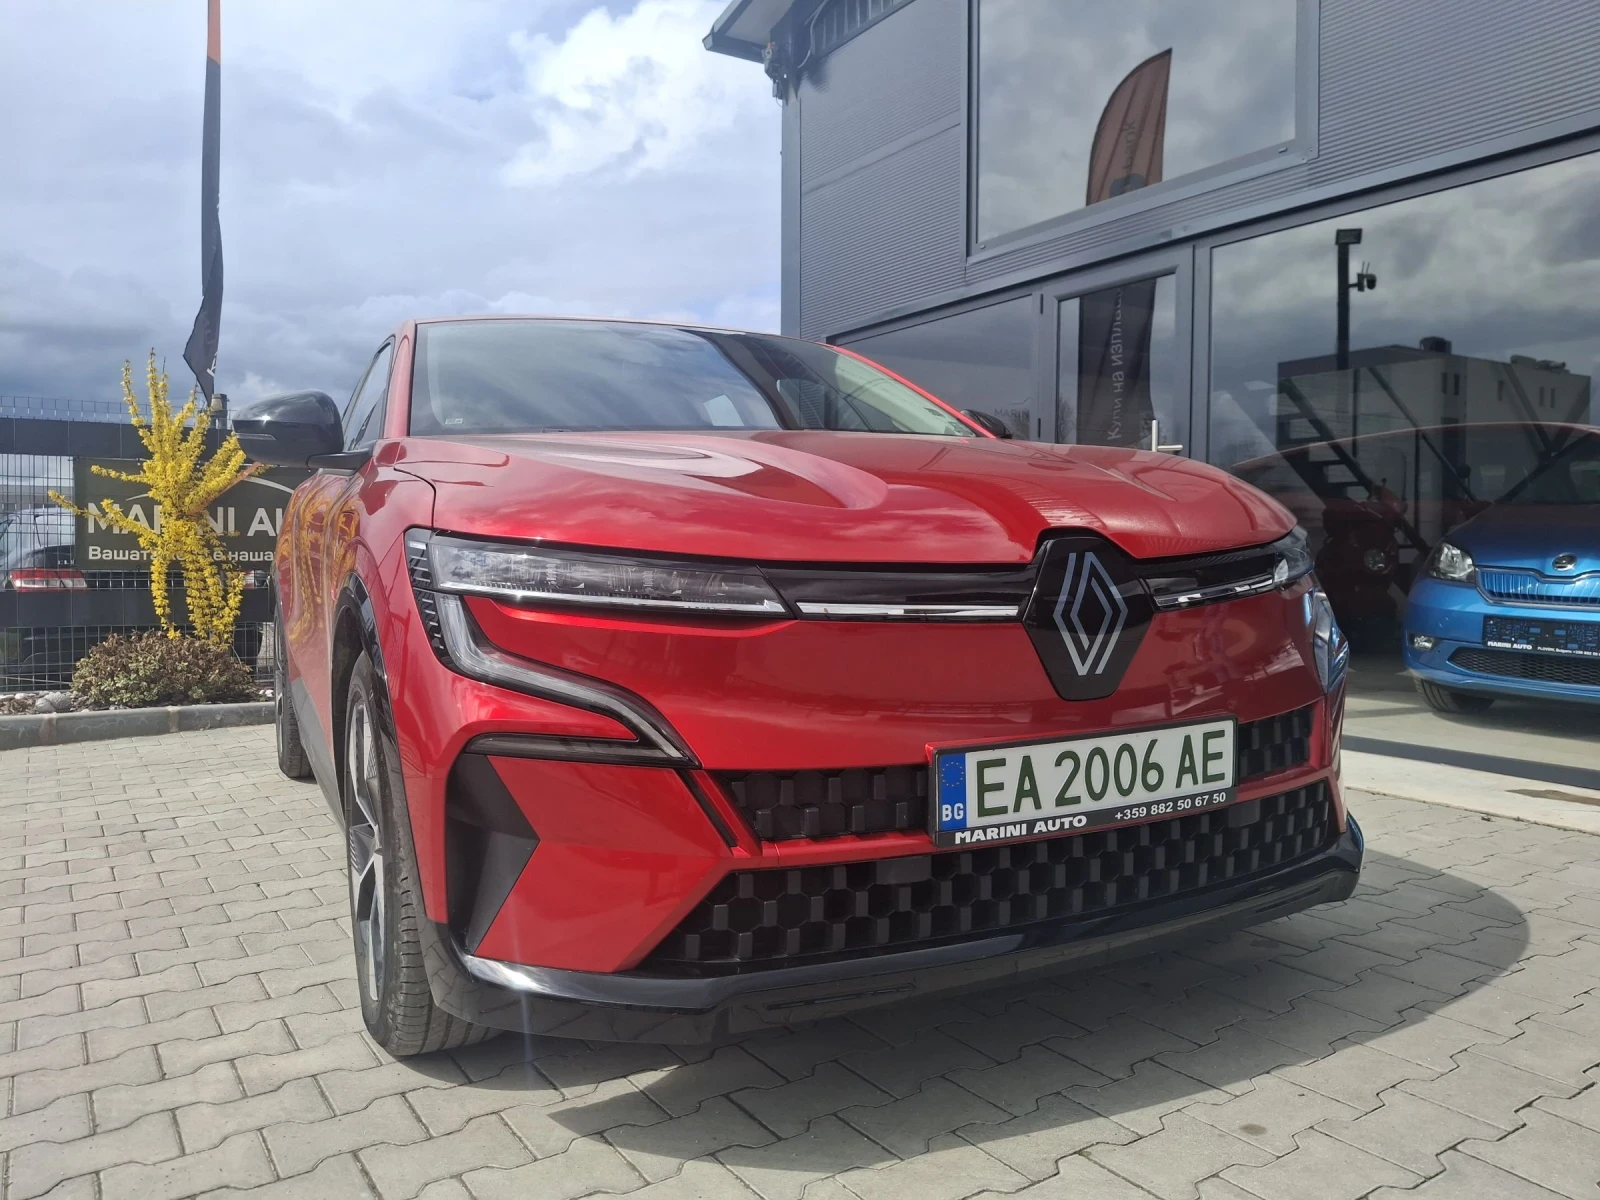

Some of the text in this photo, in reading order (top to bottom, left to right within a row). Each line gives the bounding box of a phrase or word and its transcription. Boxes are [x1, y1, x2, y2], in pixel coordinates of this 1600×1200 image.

[1111, 371, 1125, 393] на
[1107, 397, 1122, 440] Купи
[87, 502, 236, 536] MANI
[976, 729, 1226, 818] EA 2006 AE
[941, 803, 964, 822] BG
[954, 791, 1227, 845] MARINI AUTO +359 882 50 67 50
